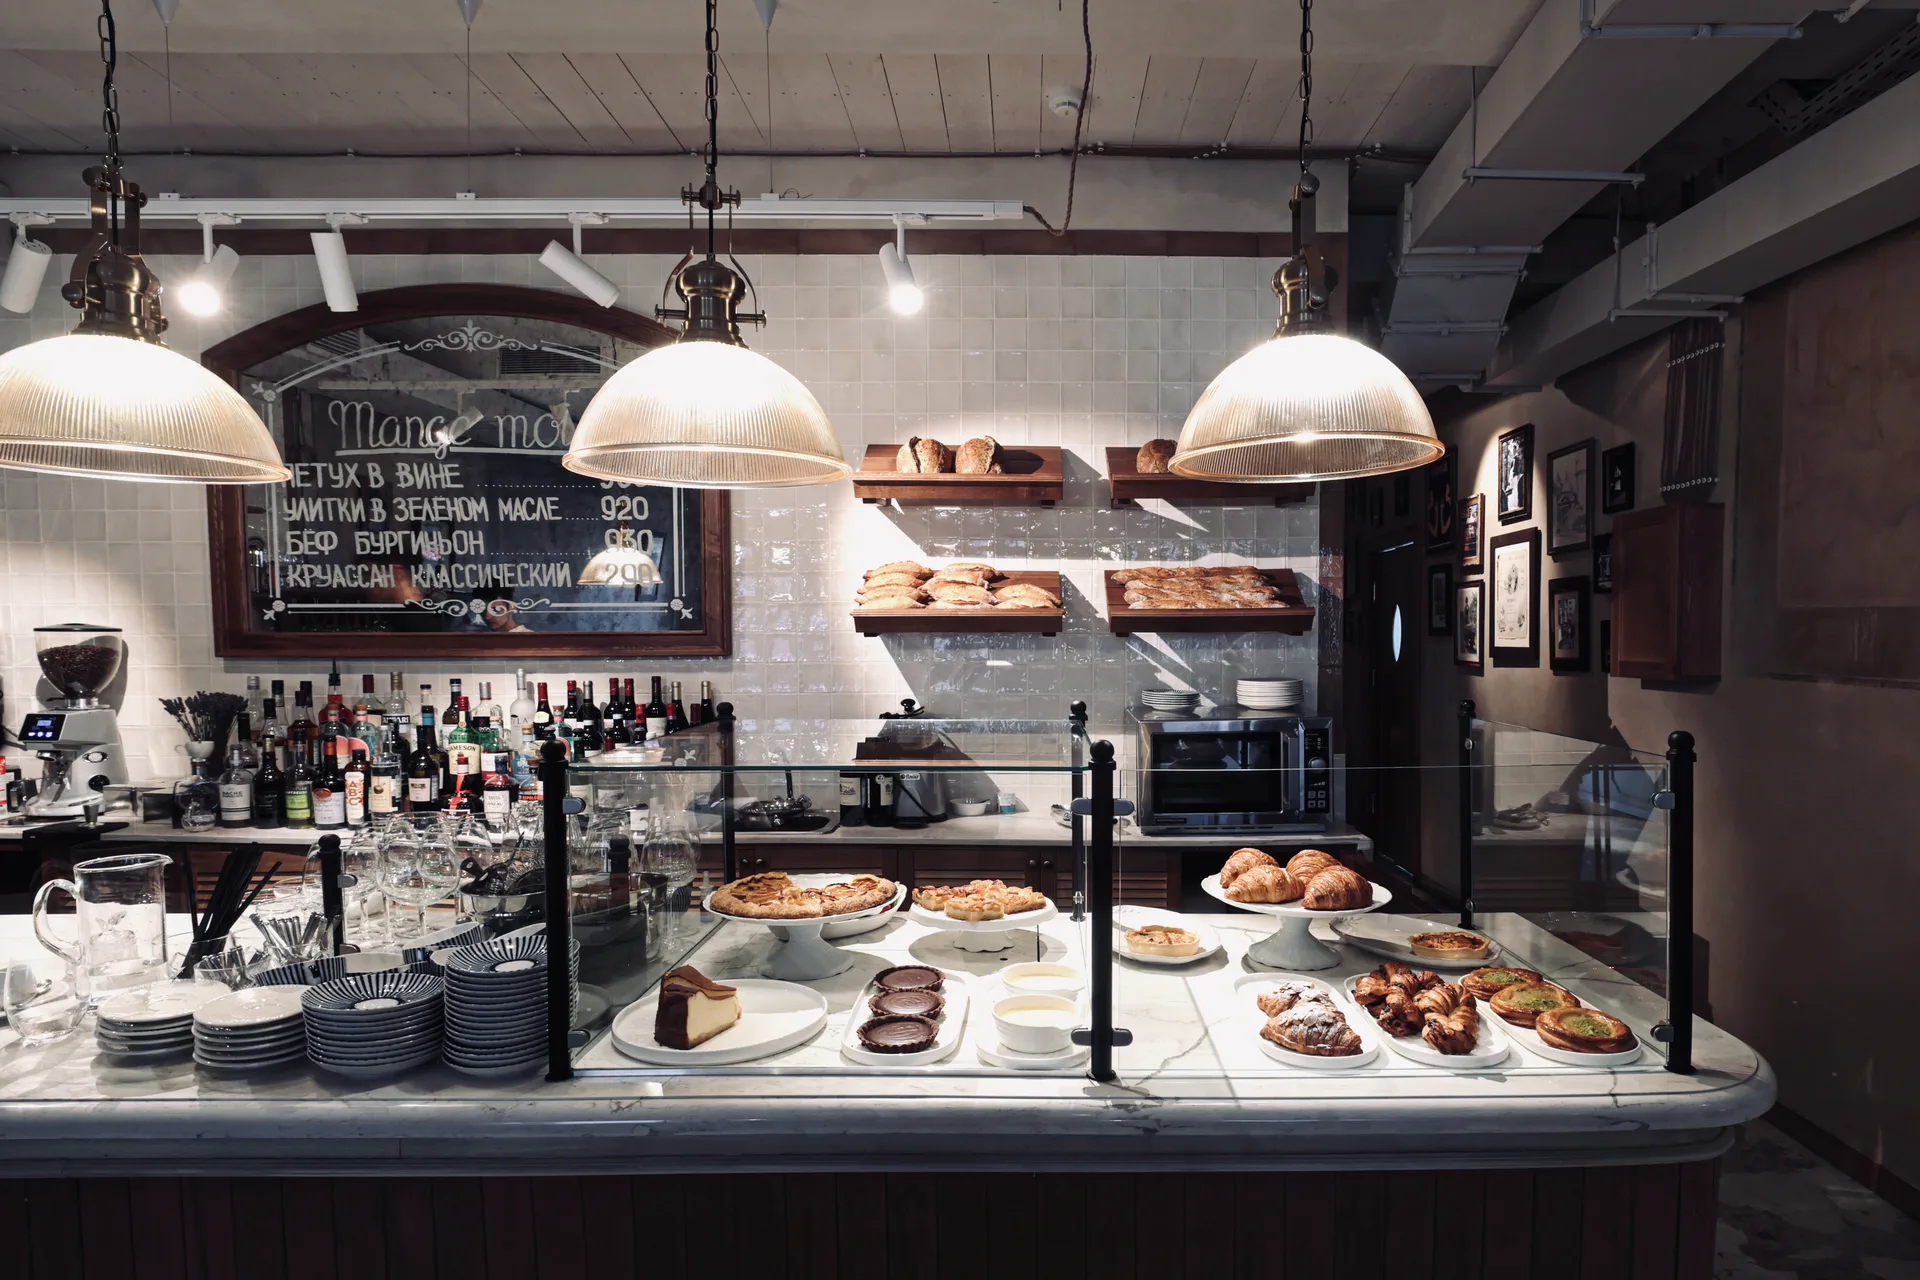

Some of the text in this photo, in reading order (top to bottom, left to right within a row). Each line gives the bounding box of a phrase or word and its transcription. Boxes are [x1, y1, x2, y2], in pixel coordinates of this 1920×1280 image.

[328, 400, 472, 460] Mange
[368, 462, 386, 489] В
[395, 462, 464, 490] ВИНЕ
[282, 494, 649, 523] УЛИТКИ В ЗЕЛЁНОМ МАСЛЕ 920
[286, 528, 338, 556] БЁФ
[354, 530, 485, 556] БУРГИНЬОН
[286, 561, 654, 588] КРУАССАН КЛАССИЧЕСКИЙ 290
